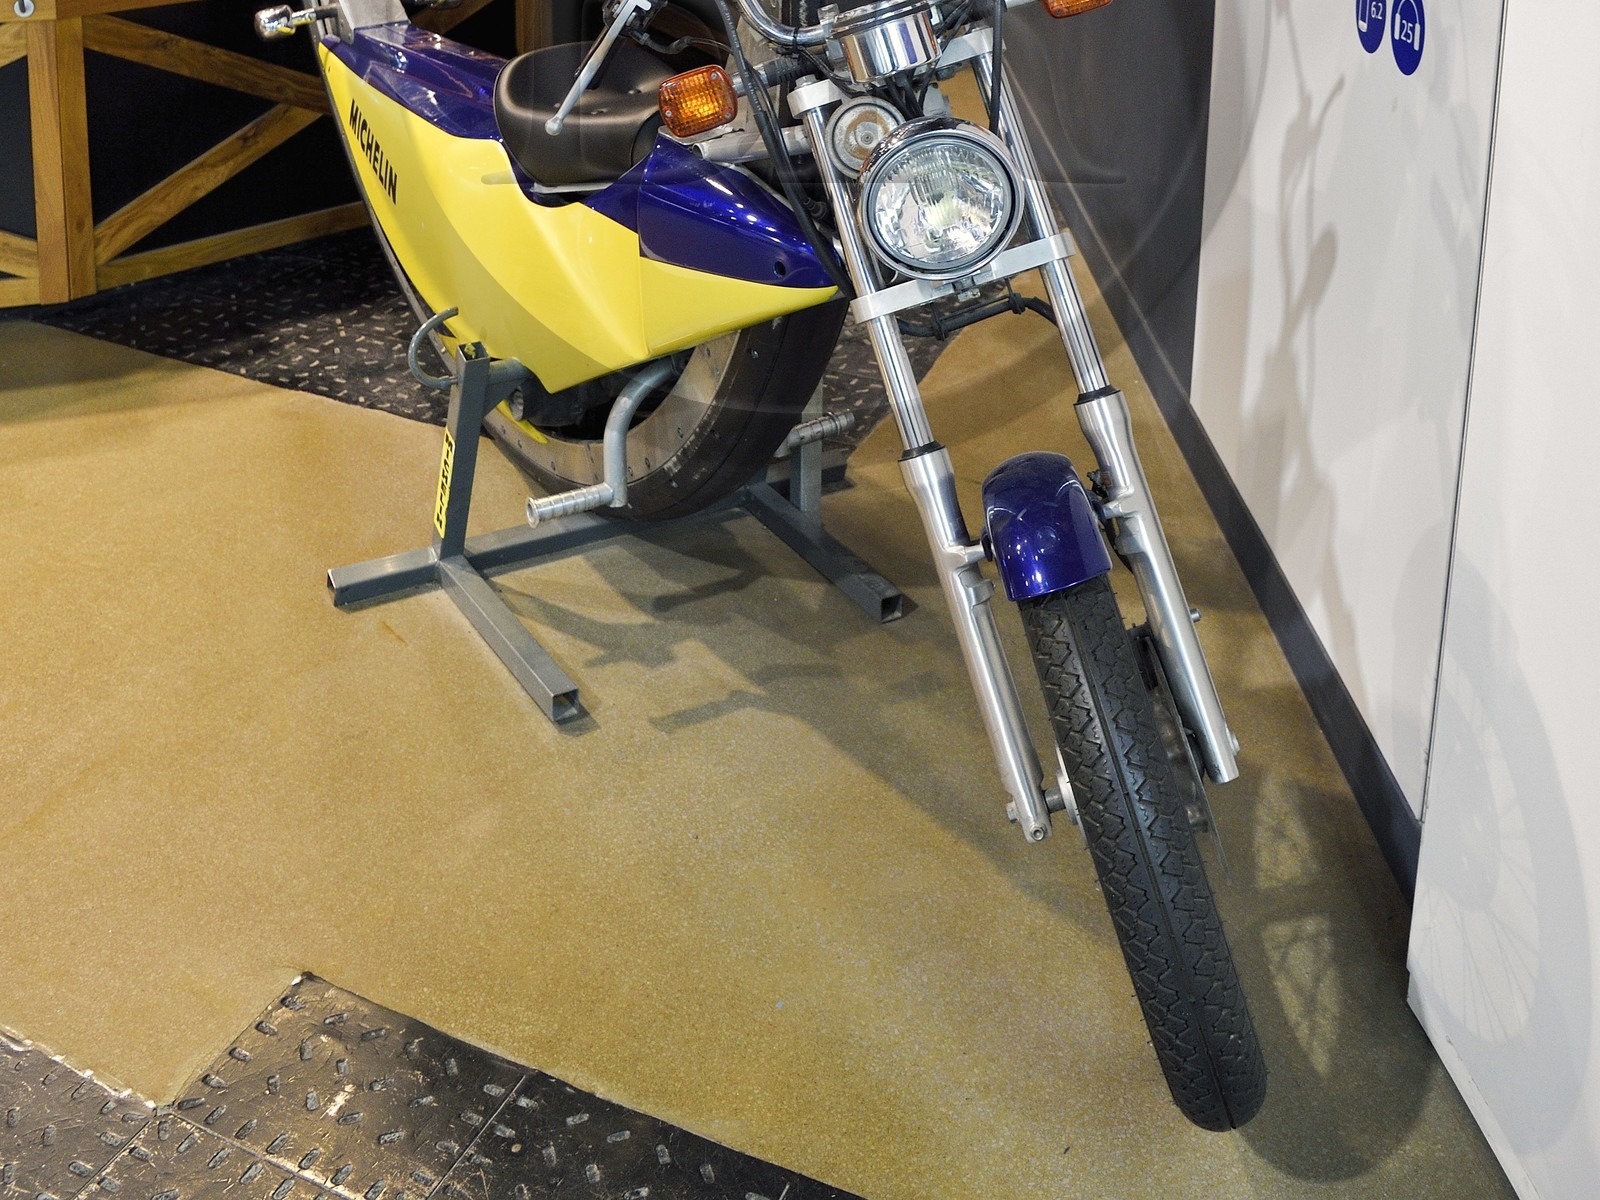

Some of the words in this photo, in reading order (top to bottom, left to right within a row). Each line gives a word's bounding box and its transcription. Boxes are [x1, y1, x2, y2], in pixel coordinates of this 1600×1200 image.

[1371, 2, 1383, 20] 6.2
[1400, 20, 1413, 44] 25
[350, 99, 398, 205] MICHELIN
[437, 433, 453, 529] MICHELIN
